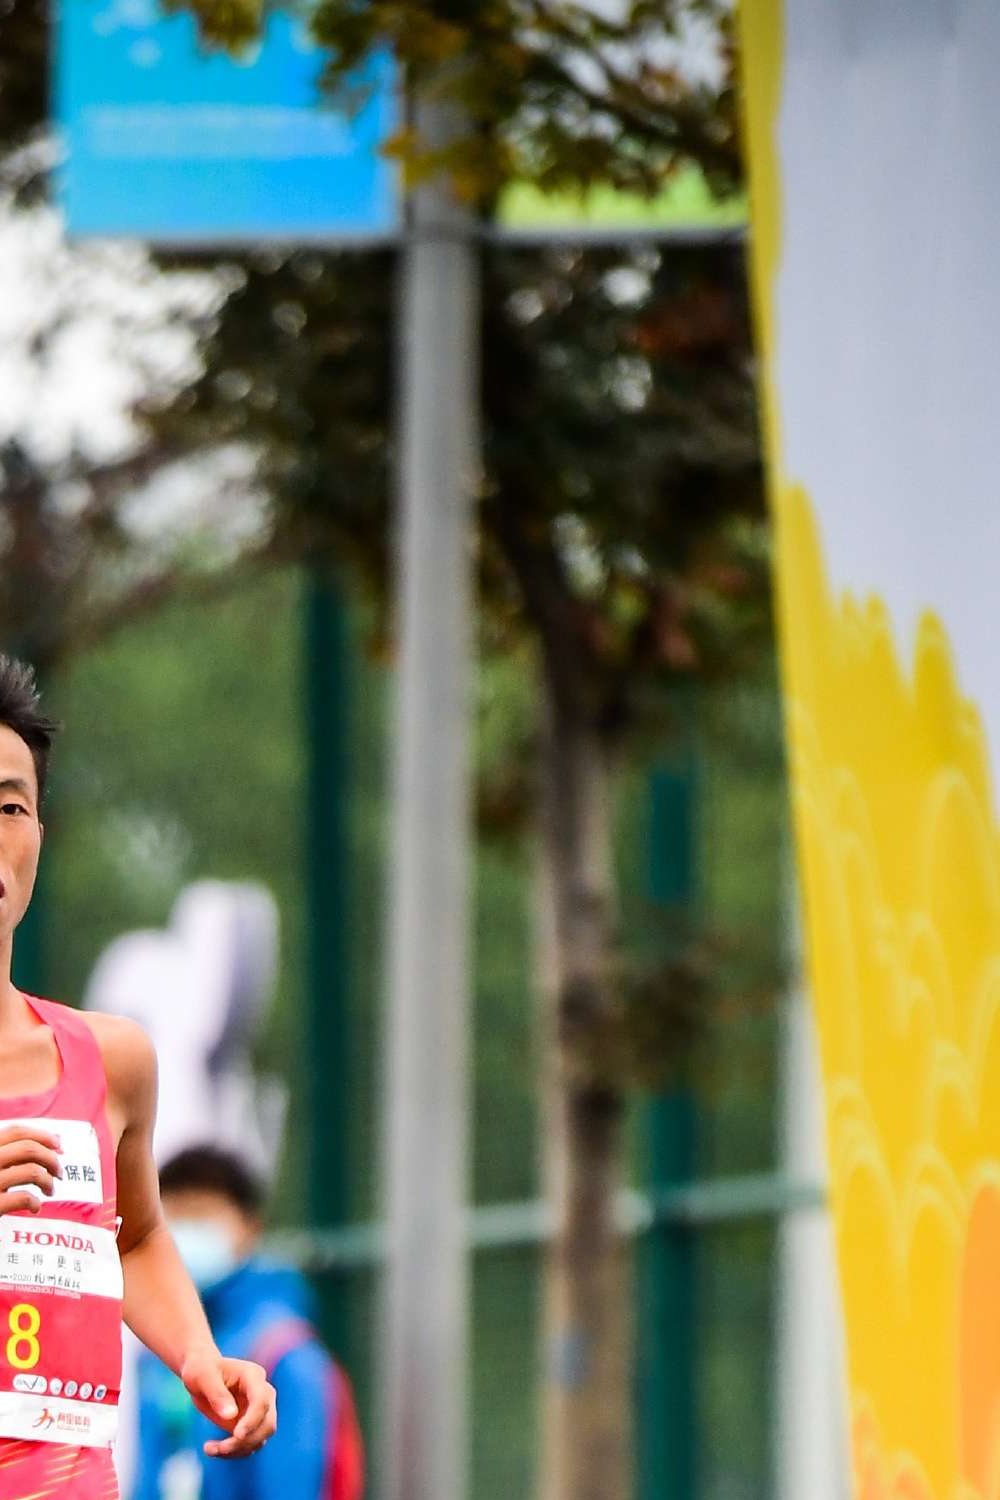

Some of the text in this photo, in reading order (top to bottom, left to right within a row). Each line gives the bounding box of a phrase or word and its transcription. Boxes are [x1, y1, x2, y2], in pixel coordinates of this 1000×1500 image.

[64, 1165, 96, 1182] 保险
[12, 1230, 96, 1254] HONDA
[6, 1303, 41, 1370] 8
